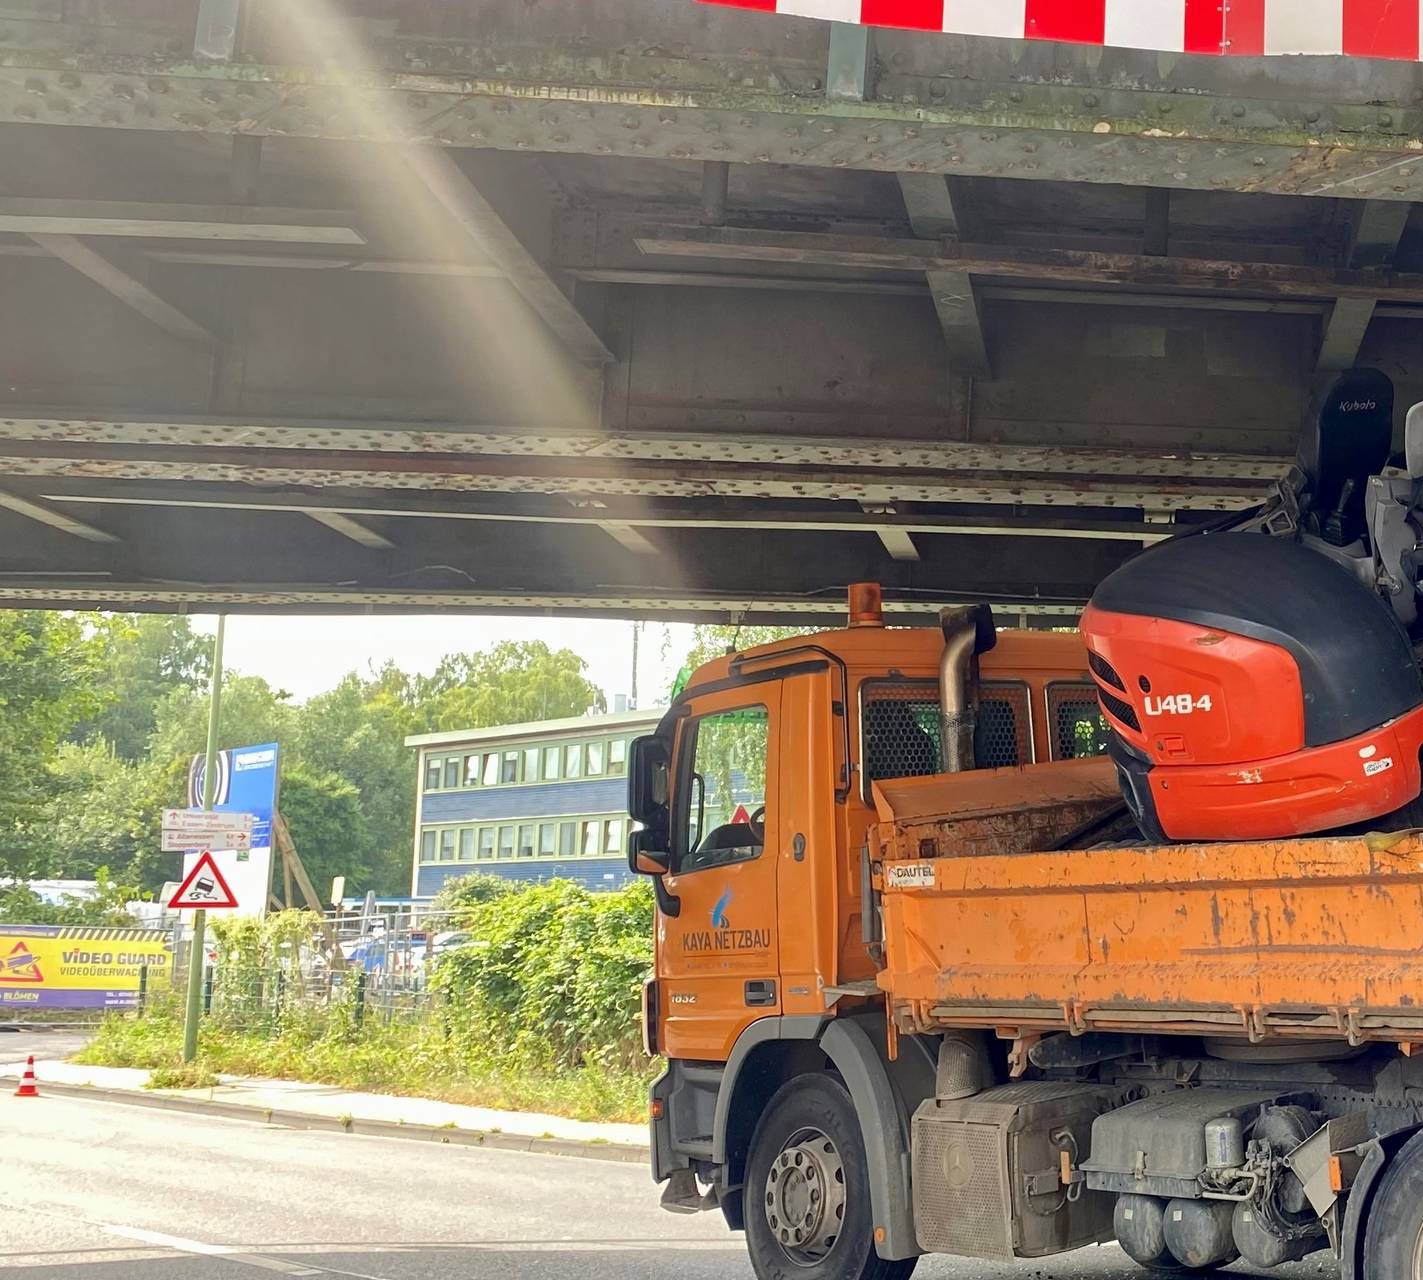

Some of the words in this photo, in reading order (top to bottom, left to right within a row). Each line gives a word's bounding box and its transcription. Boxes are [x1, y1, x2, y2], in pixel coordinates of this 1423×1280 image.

[1339, 399, 1376, 411] Kubota
[1143, 693, 1212, 716] U48-4
[896, 866, 935, 878] DAUTEL
[683, 931, 712, 951] KAYA
[714, 928, 771, 950] NETZBAU
[116, 953, 167, 966] GUARD
